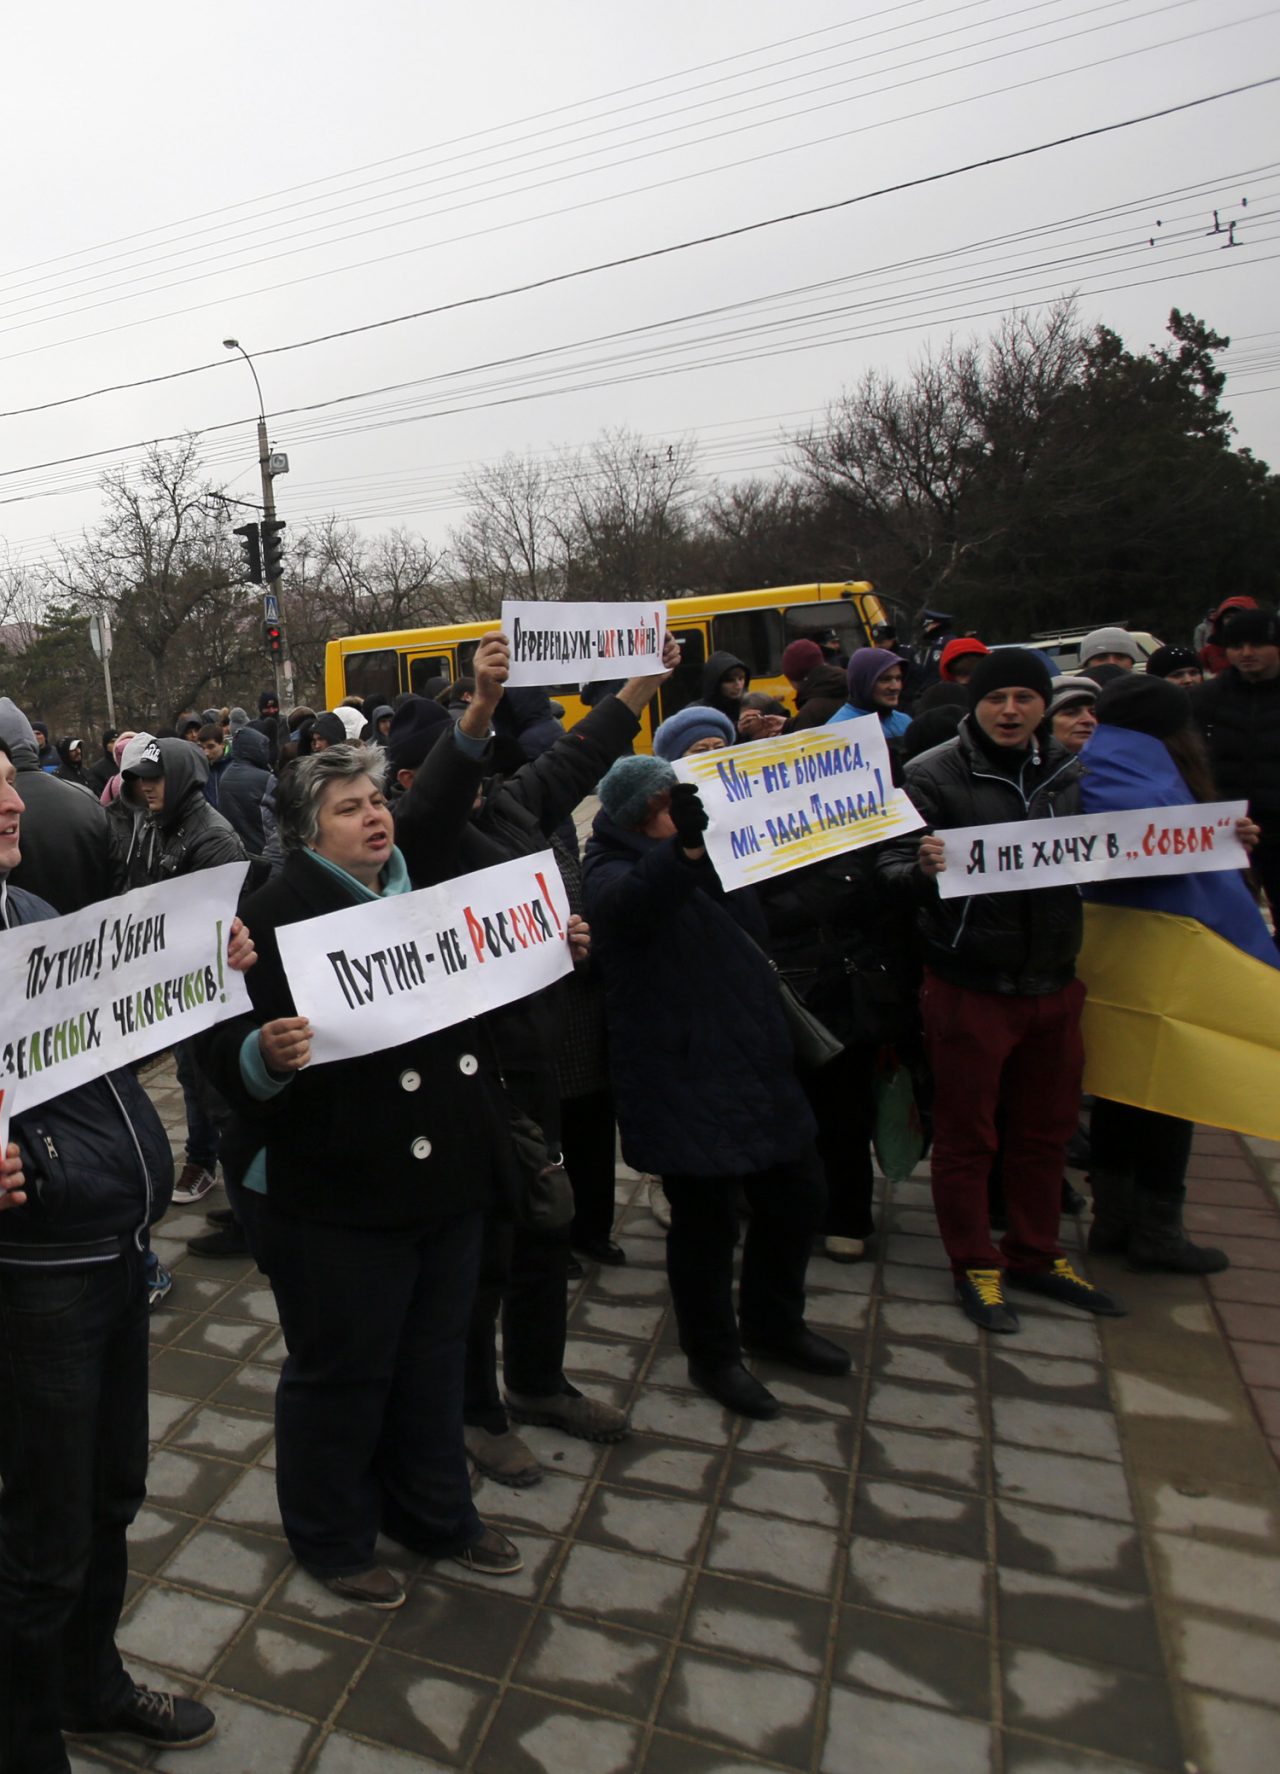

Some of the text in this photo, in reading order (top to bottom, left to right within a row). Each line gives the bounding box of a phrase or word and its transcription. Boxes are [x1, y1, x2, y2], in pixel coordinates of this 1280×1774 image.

[966, 839, 986, 875] Я
[998, 844, 1024, 871] НЕ
[1032, 835, 1098, 867] ХОЧУ
[1106, 833, 1119, 858] В
[26, 913, 166, 999] ПУТИН! УБЕРИ
[463, 872, 566, 963] РОССИЯ!
